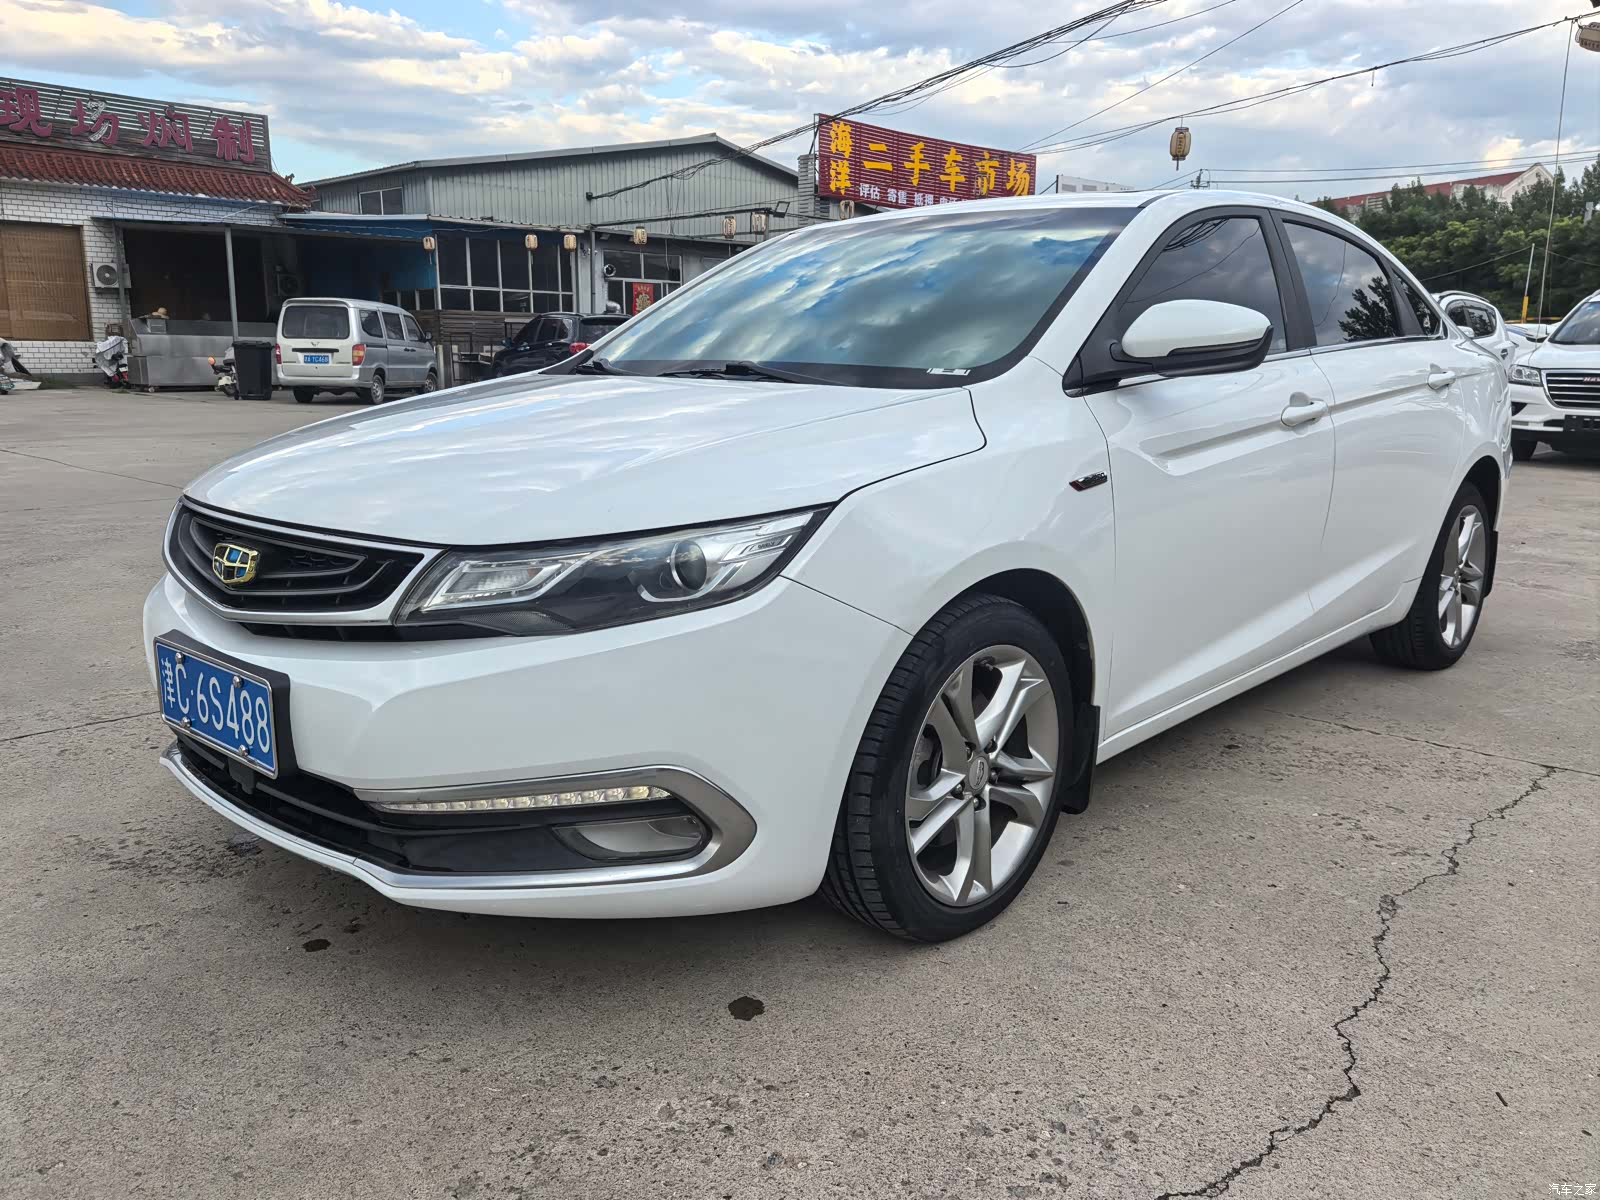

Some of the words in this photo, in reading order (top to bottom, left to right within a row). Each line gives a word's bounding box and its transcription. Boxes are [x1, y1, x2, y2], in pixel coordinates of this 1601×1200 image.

[0, 87, 255, 164] 现场焖制
[830, 121, 852, 195] 海洋
[859, 183, 880, 200] 评估
[887, 188, 907, 204] 寄售
[863, 142, 1030, 196] 二手车市场
[161, 656, 270, 754] 津C·6S488
